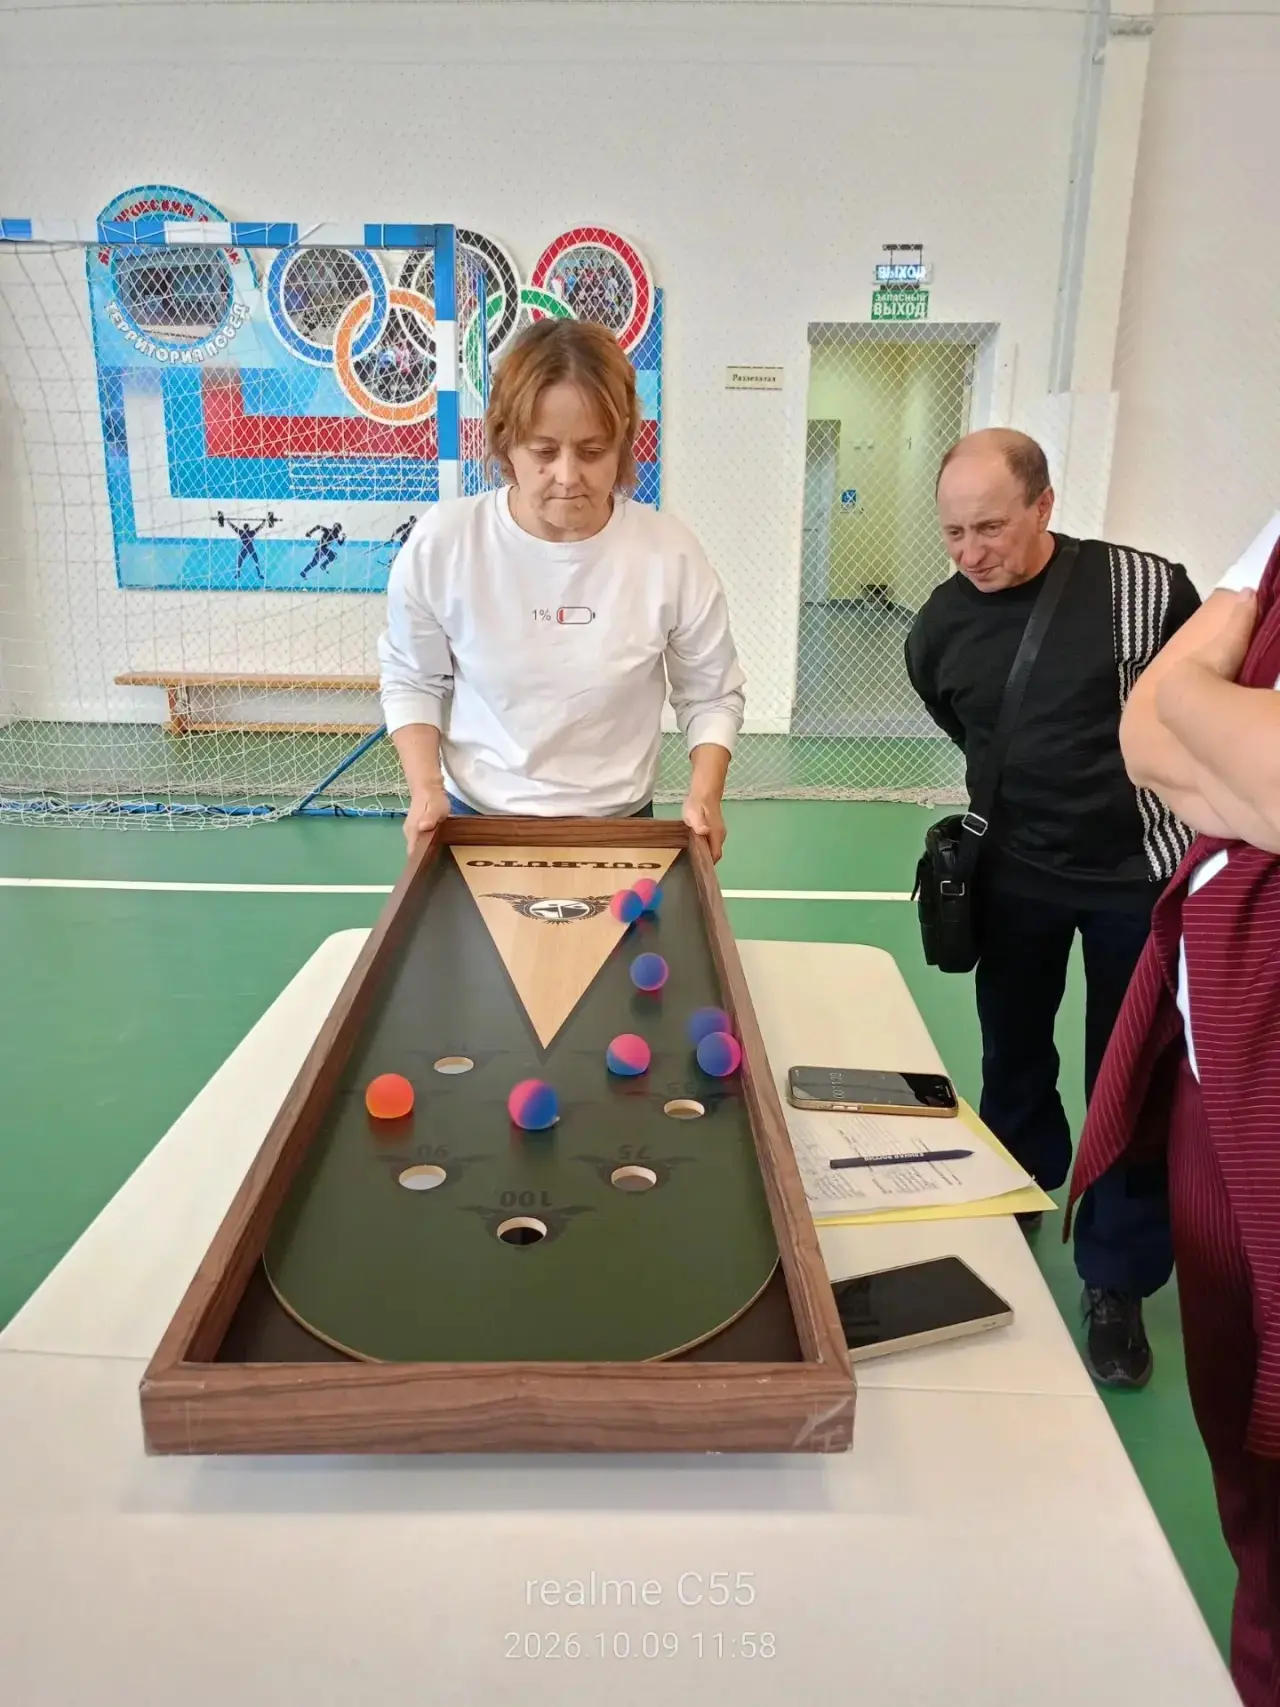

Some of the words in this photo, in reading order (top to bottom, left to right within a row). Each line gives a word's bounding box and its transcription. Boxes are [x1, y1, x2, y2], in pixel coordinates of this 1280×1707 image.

[877, 265, 927, 280] ВЫХОД
[873, 302, 927, 318] ВЫХОД
[104, 301, 205, 366] ТЕРРИТОРИЯ
[532, 608, 552, 621] 1%
[466, 859, 662, 870] CULBUTO
[617, 1144, 653, 1161] 75
[500, 1189, 554, 1208] 100
